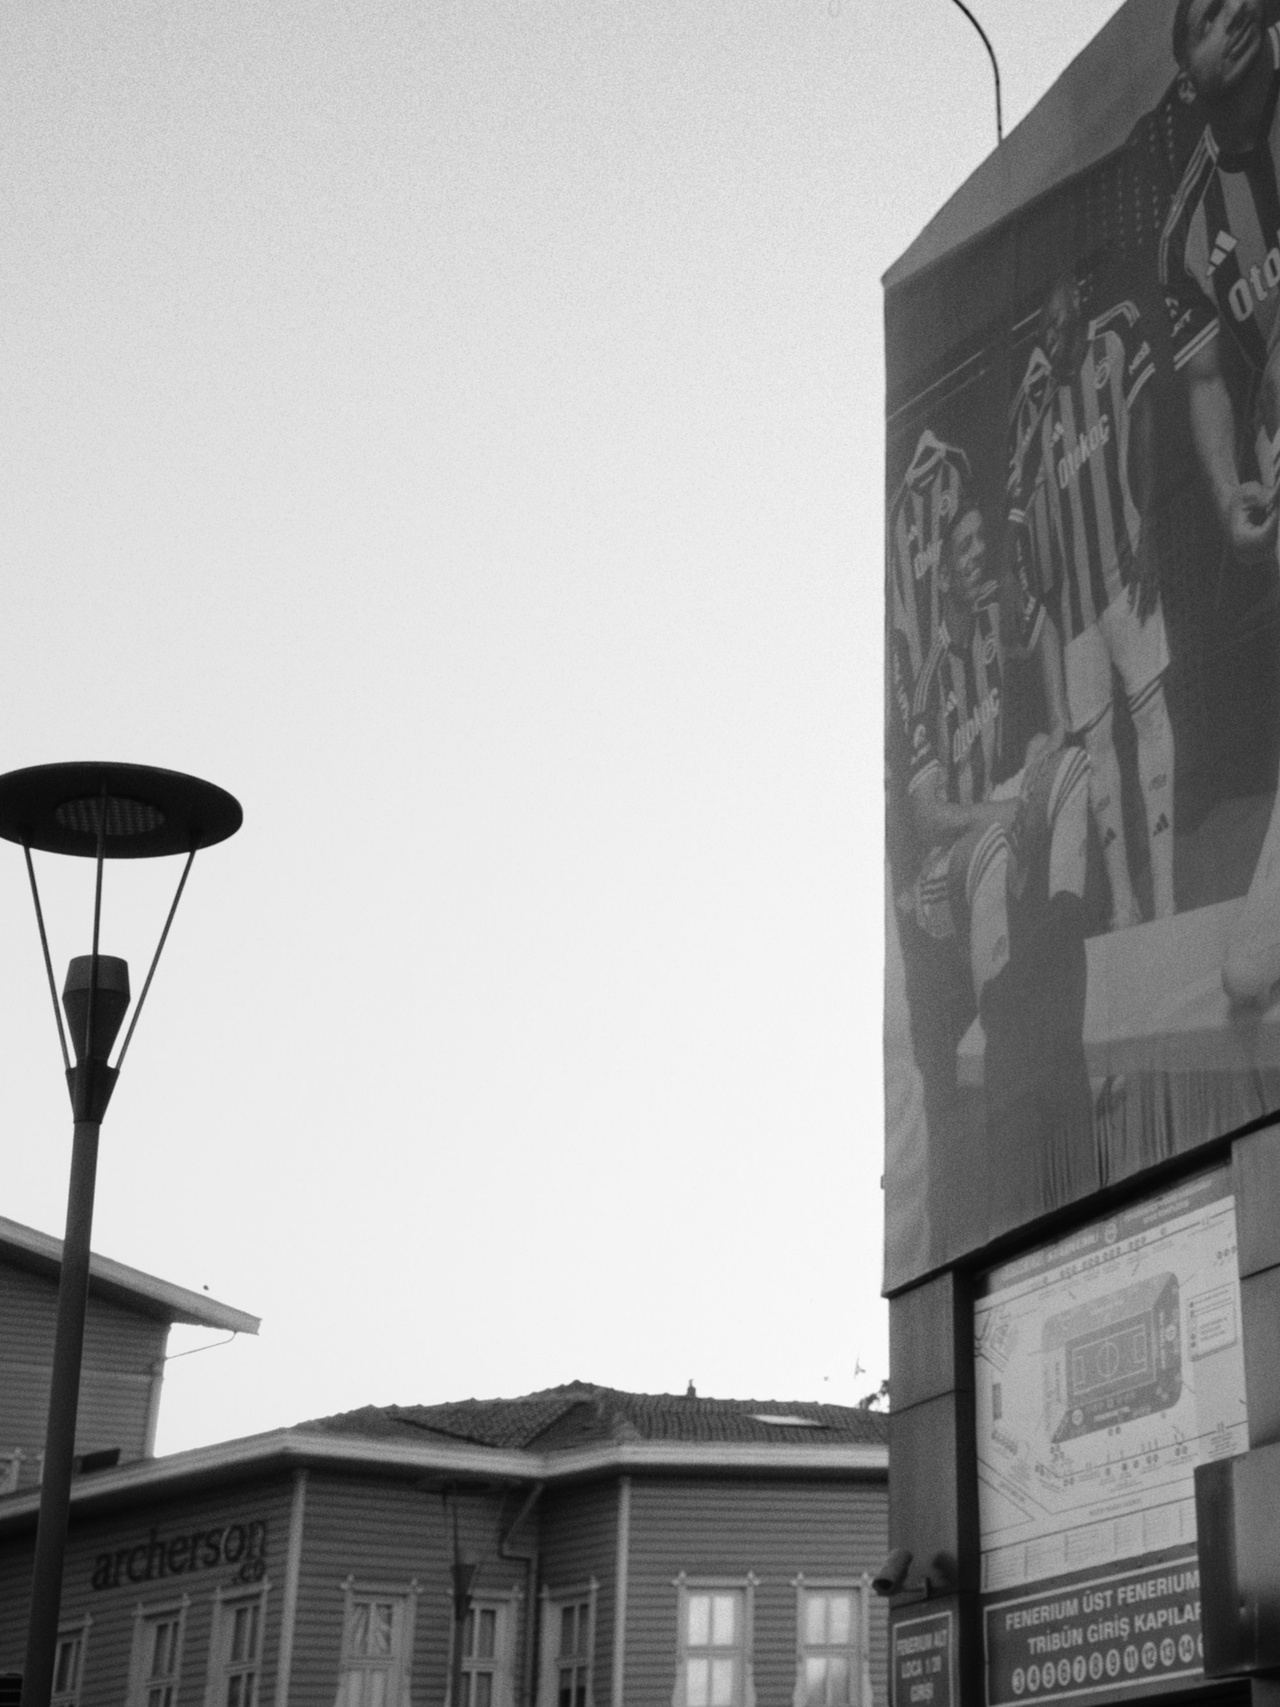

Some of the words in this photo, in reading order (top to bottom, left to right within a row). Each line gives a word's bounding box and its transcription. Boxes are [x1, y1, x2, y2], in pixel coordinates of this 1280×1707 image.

[91, 1520, 266, 1590] archerson
[1005, 1598, 1080, 1631] FENERIUM
[1082, 1590, 1114, 1613] ÜST
[1117, 1570, 1200, 1606] FENERIUM
[1027, 1625, 1083, 1655] TRİBÜN
[1087, 1614, 1130, 1641] GİRİŞ
[1074, 1659, 1084, 1680] 7
[1125, 1649, 1137, 1669] 11
